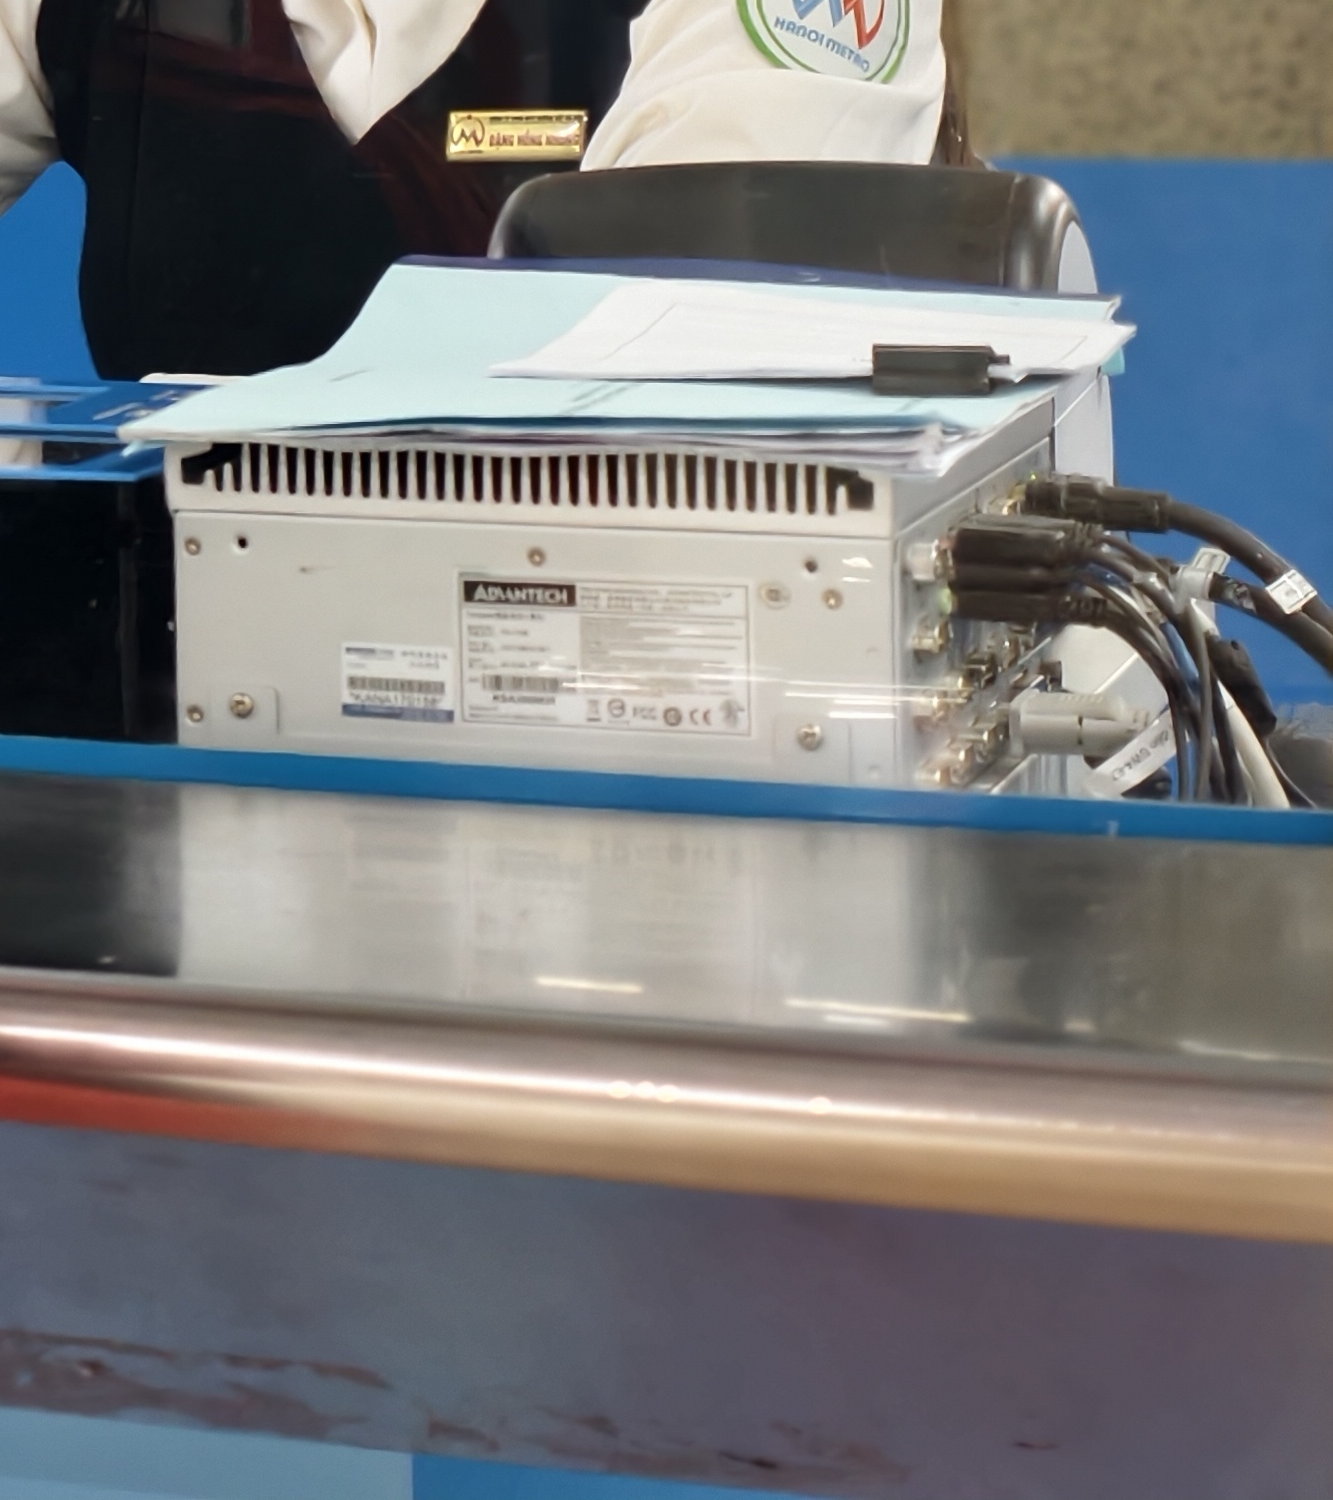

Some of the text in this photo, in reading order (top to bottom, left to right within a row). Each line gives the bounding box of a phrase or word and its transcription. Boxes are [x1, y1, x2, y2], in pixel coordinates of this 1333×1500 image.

[773, 15, 871, 73] HANOI METRO
[472, 583, 569, 605] ADVANTECH
